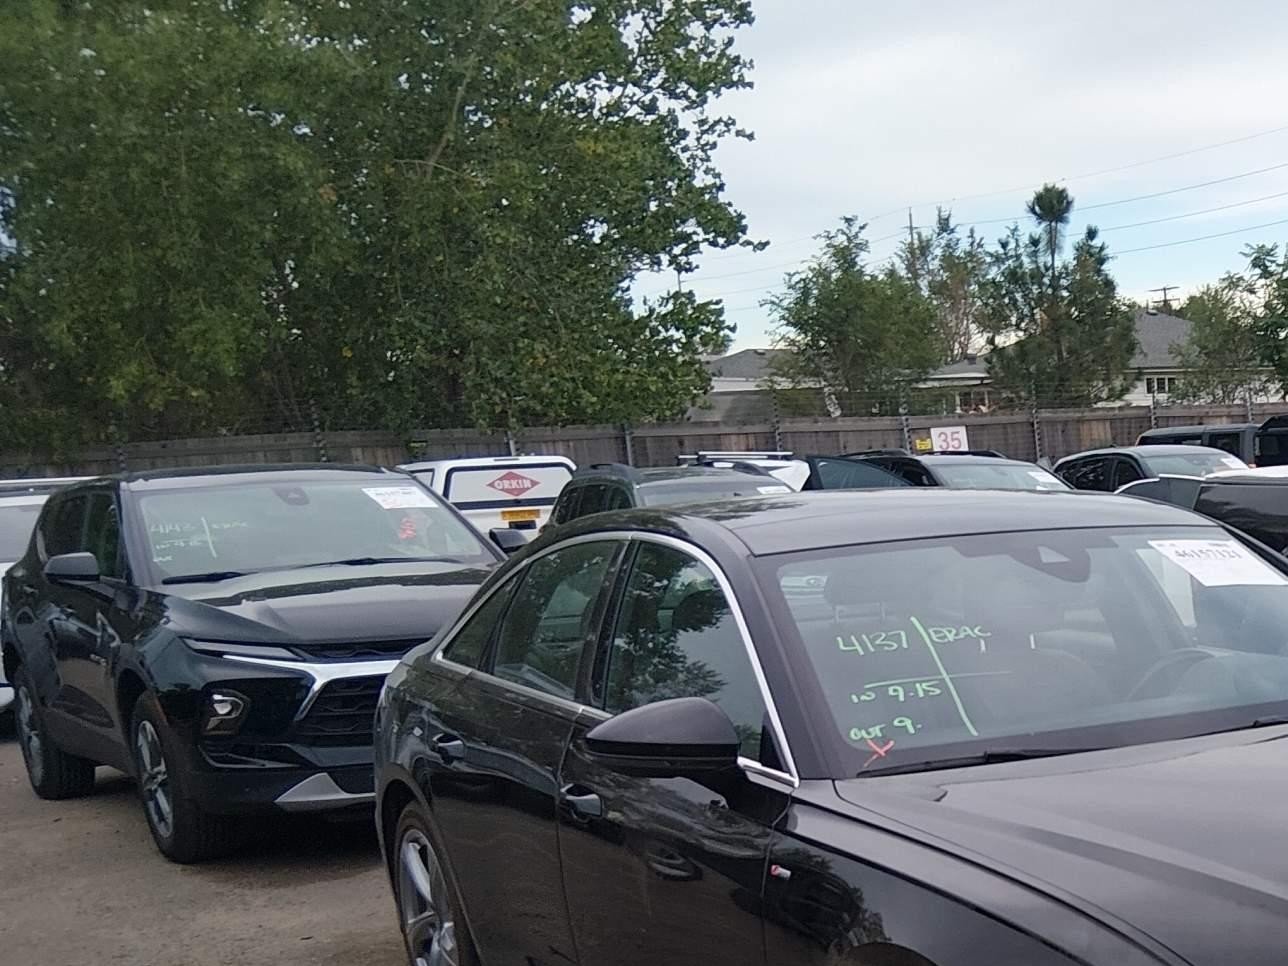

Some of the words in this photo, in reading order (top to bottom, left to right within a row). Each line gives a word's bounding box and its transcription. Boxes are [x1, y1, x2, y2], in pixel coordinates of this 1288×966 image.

[938, 431, 961, 450] 35
[494, 479, 532, 489] ORKIN
[836, 629, 908, 656] 4137
